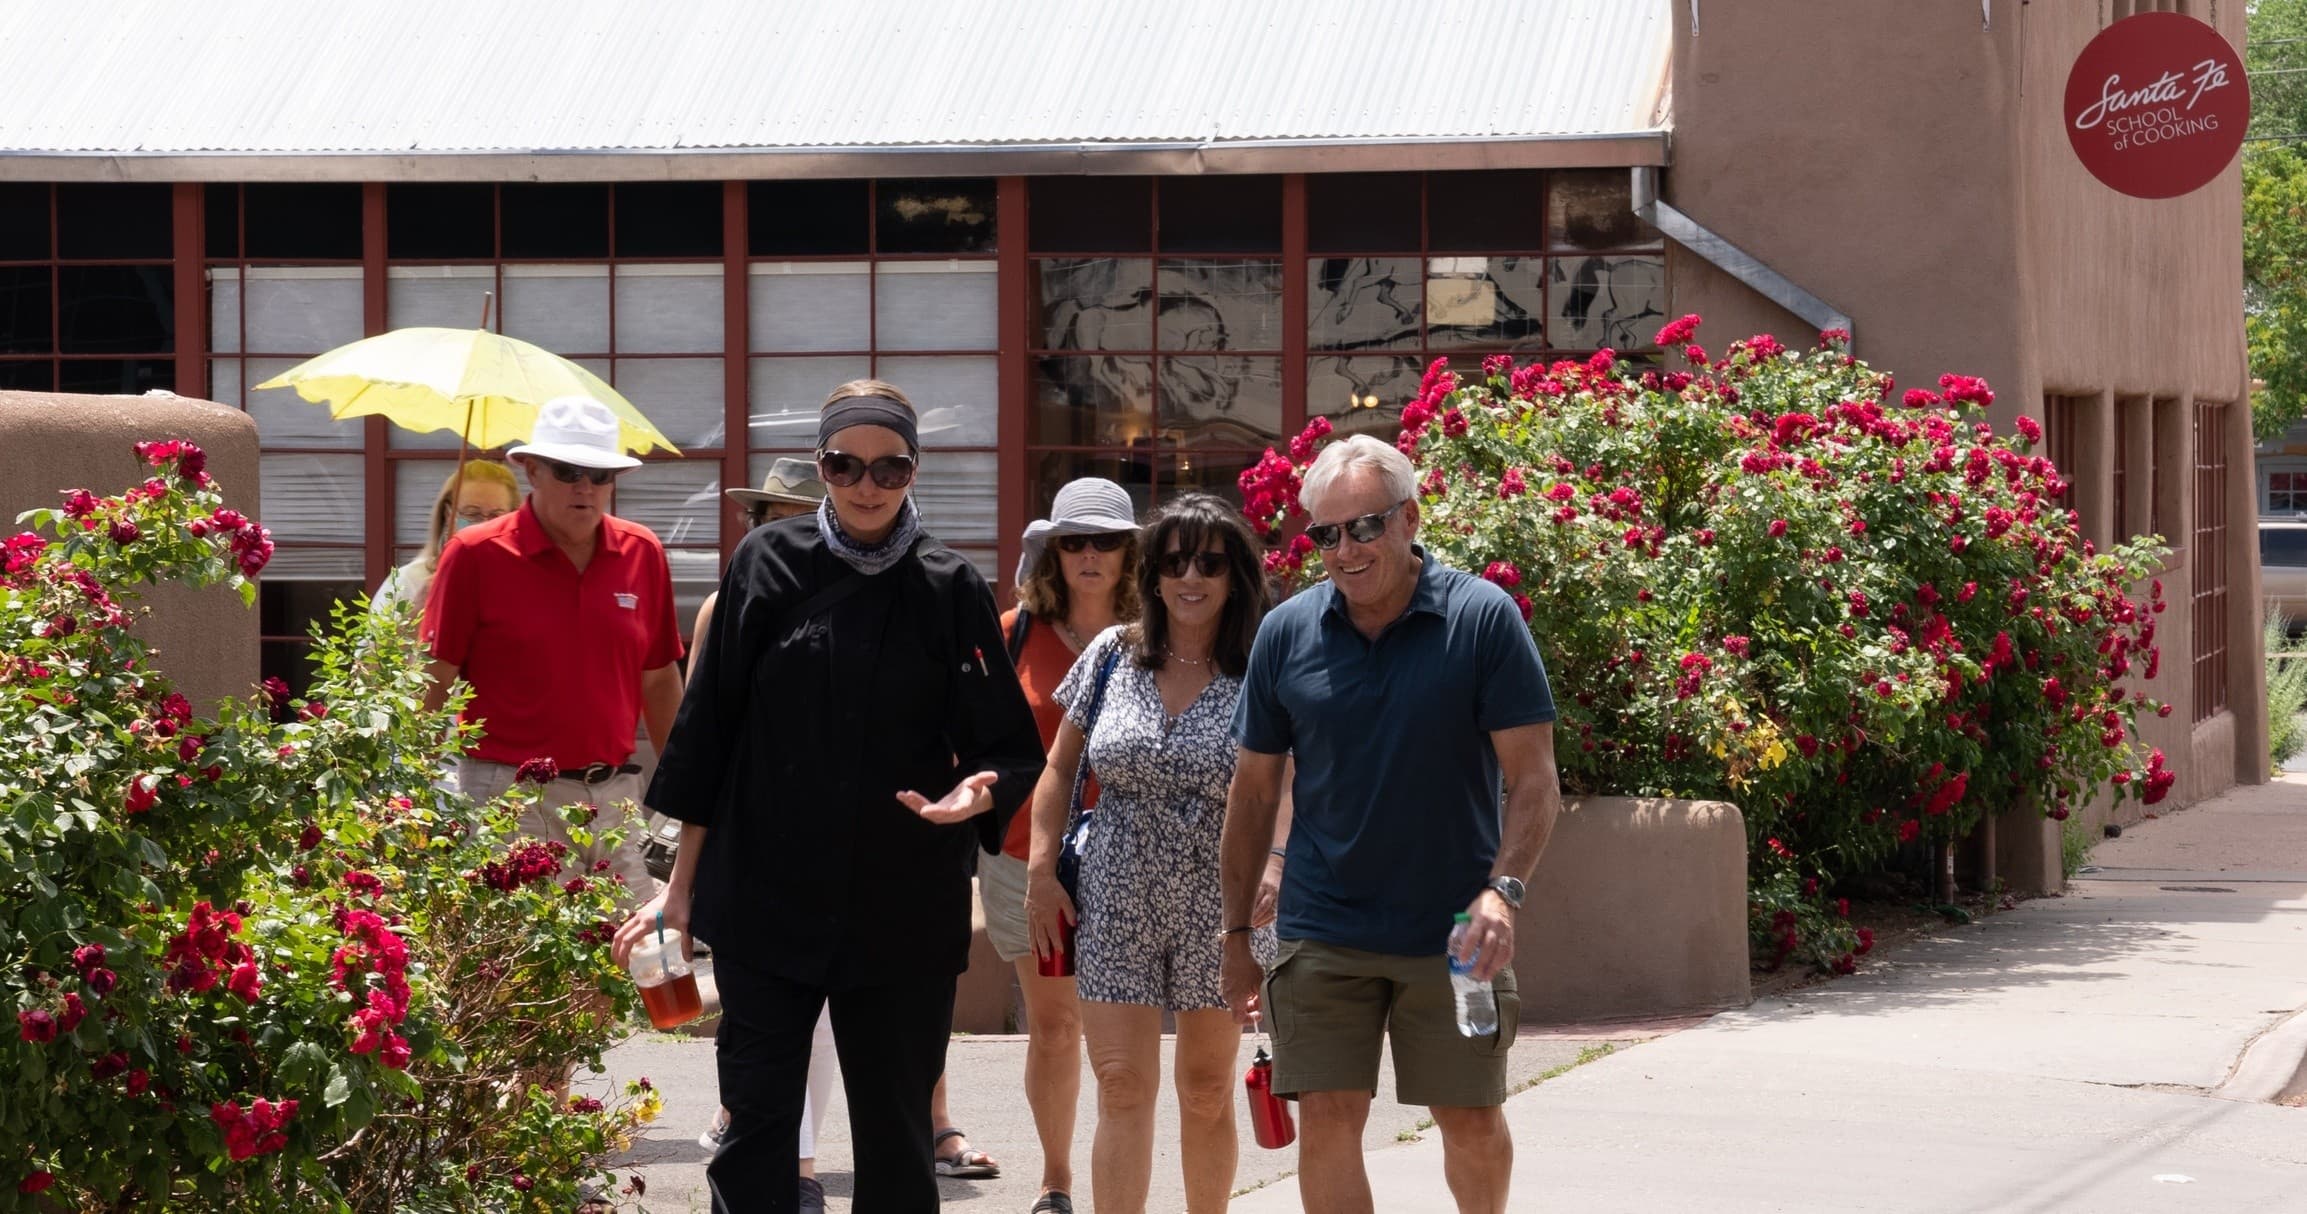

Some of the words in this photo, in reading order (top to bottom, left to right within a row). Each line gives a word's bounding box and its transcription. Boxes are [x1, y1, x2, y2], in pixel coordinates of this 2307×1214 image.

[2075, 72, 2186, 129] Santa
[2187, 59, 2229, 110] Fe
[2106, 107, 2183, 136] SCHOOL
[2113, 134, 2130, 150] of
[2132, 115, 2218, 146] COOKING
